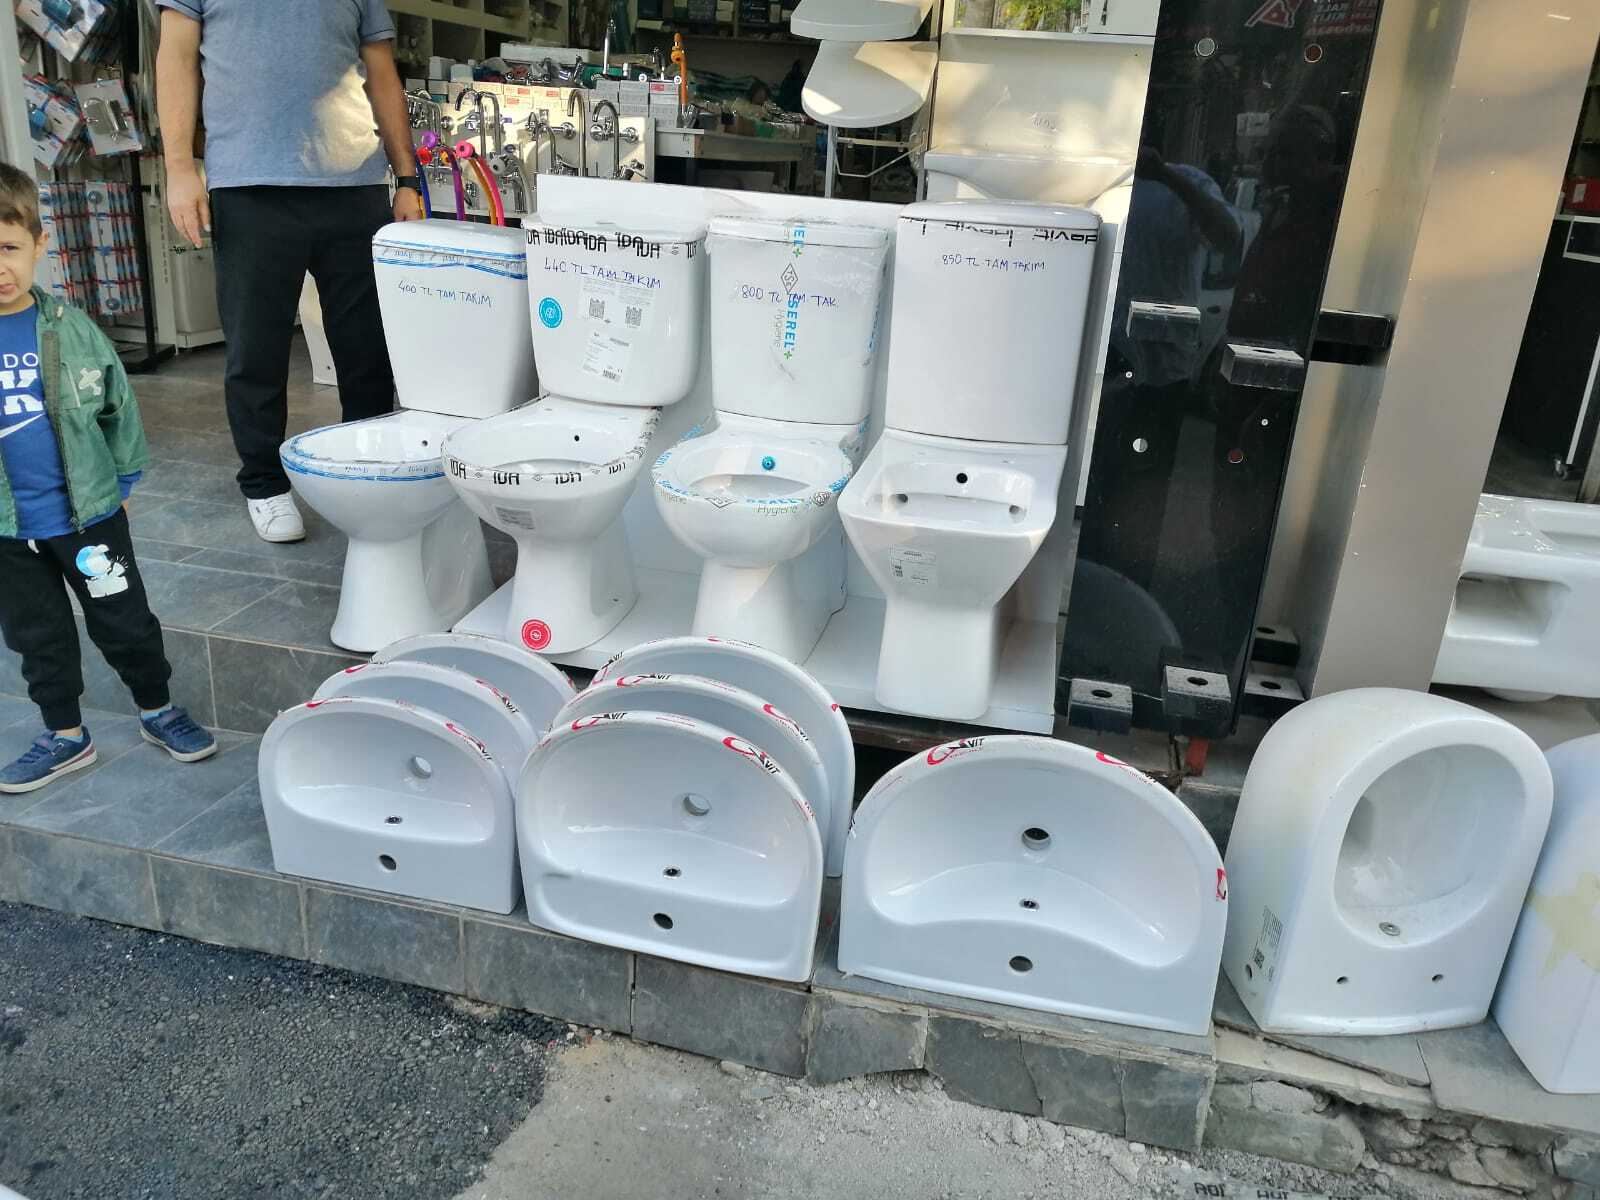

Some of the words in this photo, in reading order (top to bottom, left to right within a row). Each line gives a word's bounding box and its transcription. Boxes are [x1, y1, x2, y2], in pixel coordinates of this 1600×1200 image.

[571, 262, 588, 275] TL
[591, 265, 617, 280] TAM
[942, 253, 963, 266] 850
[965, 257, 980, 268] TL
[984, 259, 1009, 271] TAM
[1012, 260, 1046, 272] TAKIM
[398, 279, 417, 294] 400
[420, 286, 432, 297] TL
[437, 289, 456, 301] TAM
[741, 284, 764, 300] 800
[768, 291, 783, 304] TL
[788, 293, 806, 304] TAM
[783, 299, 799, 349] SEREL
